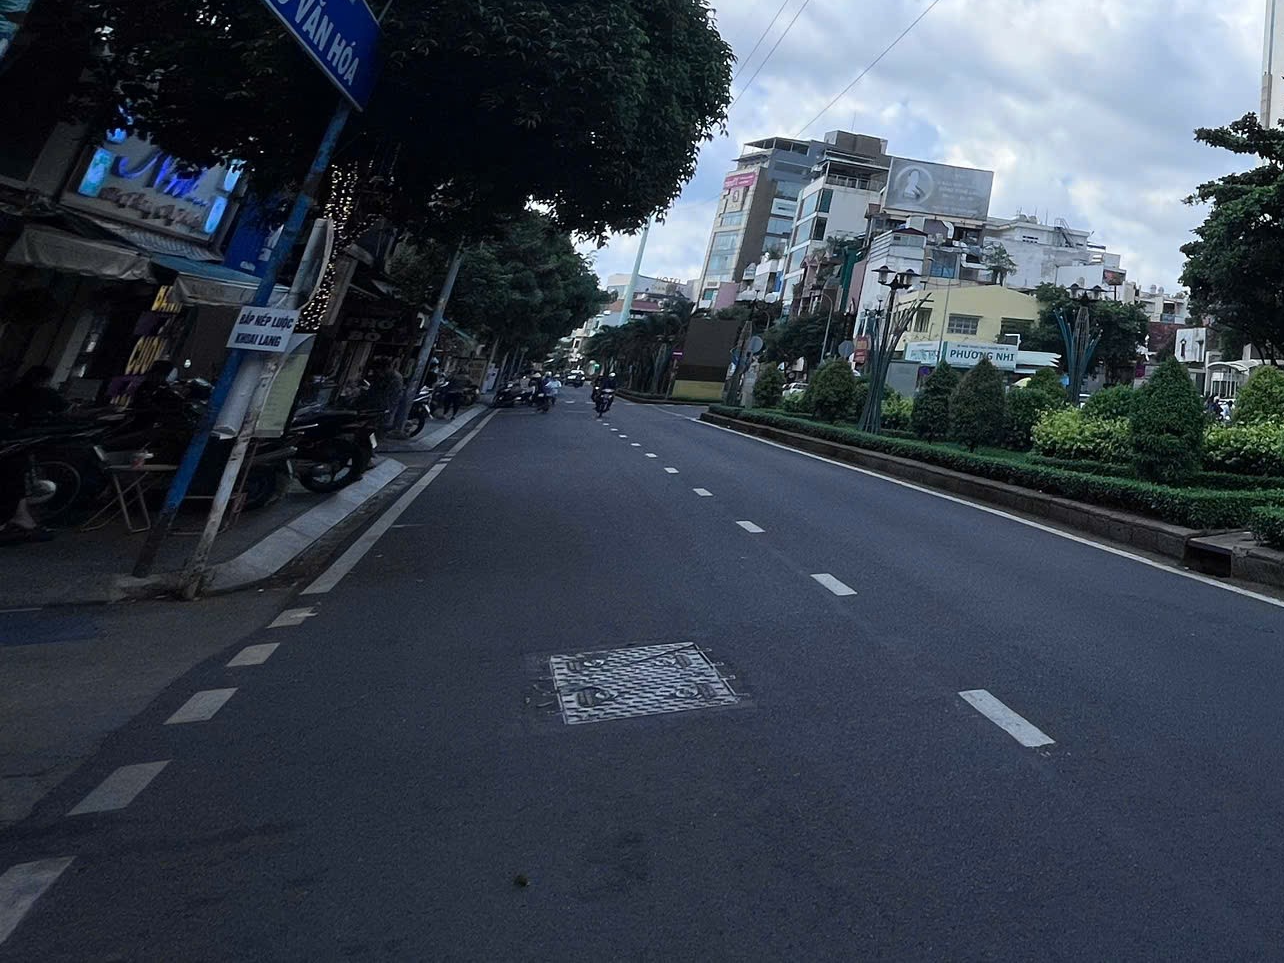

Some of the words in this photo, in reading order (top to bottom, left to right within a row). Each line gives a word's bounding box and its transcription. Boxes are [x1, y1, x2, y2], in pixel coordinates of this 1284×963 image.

[326, 32, 360, 85] HÓA
[234, 333, 259, 345] KHOAI
[258, 335, 282, 347] LANG
[996, 353, 1015, 362] NHI
